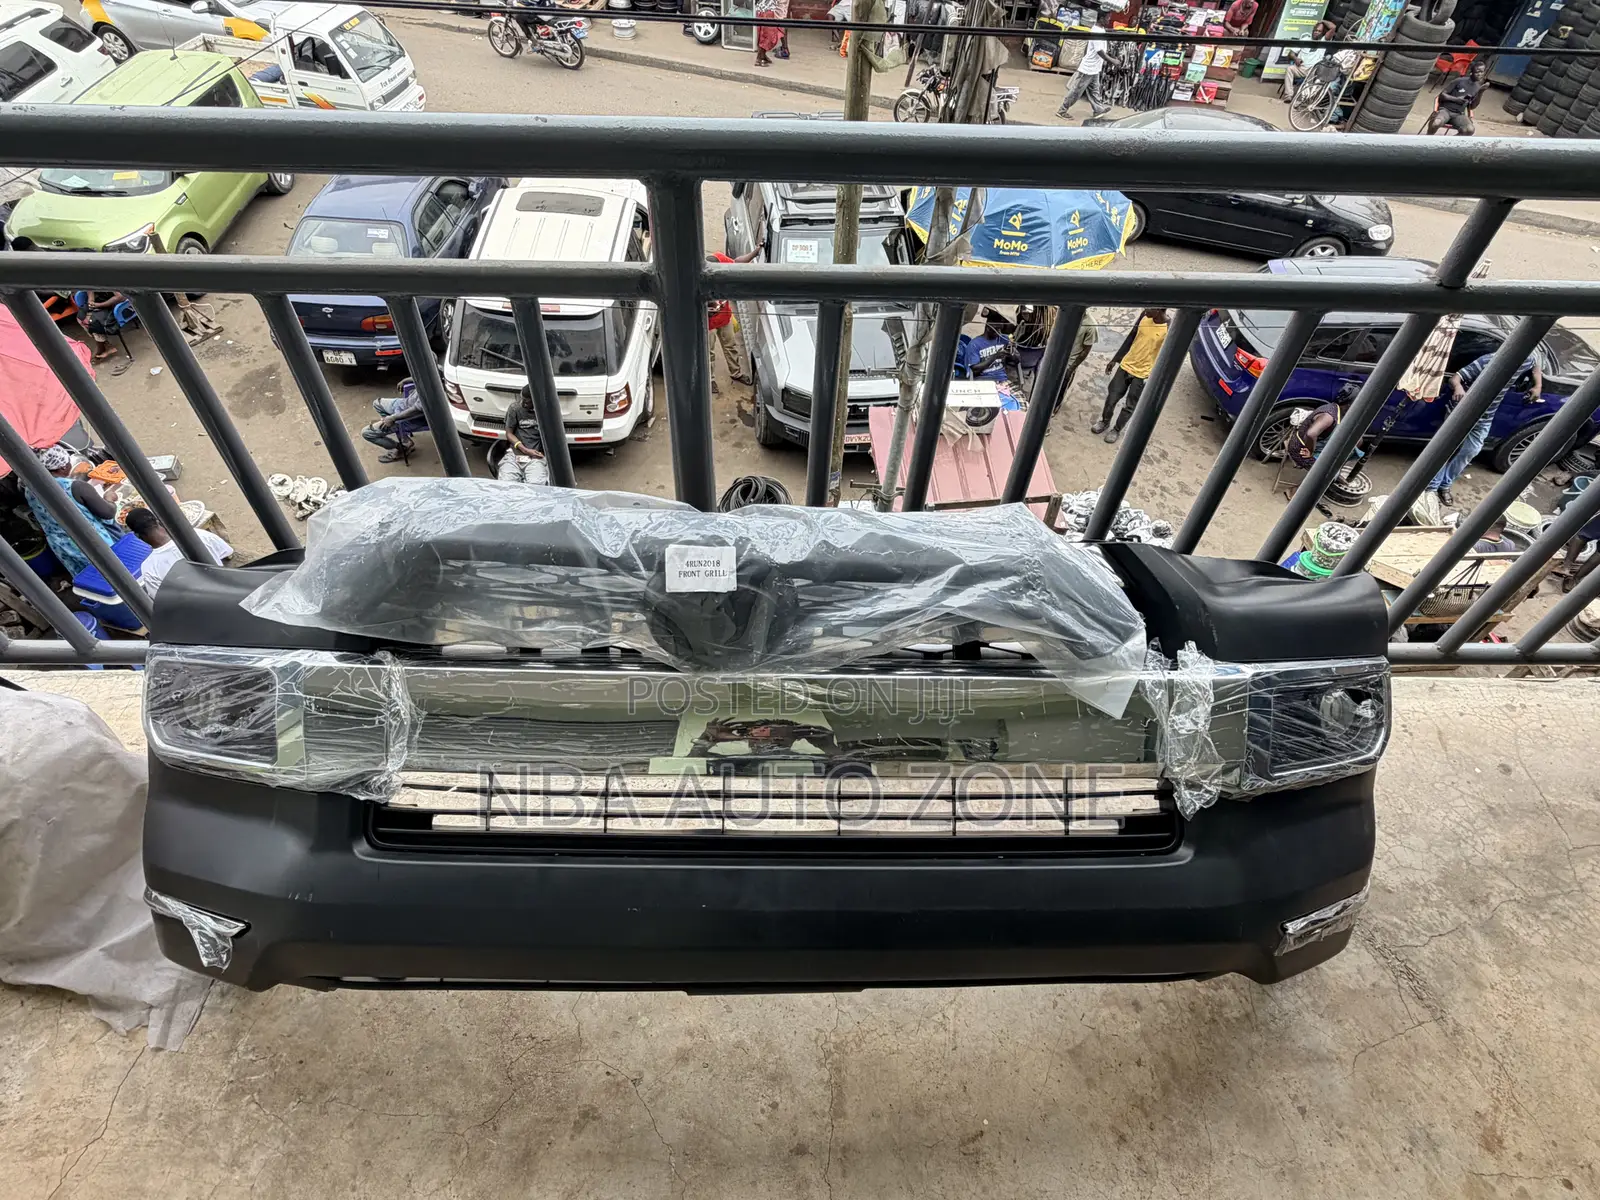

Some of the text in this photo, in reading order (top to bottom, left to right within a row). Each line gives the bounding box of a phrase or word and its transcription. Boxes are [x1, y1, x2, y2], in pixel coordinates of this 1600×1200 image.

[993, 238, 1028, 252] MoMo
[1067, 236, 1089, 250] MoMo
[678, 570, 700, 578] FRONT
